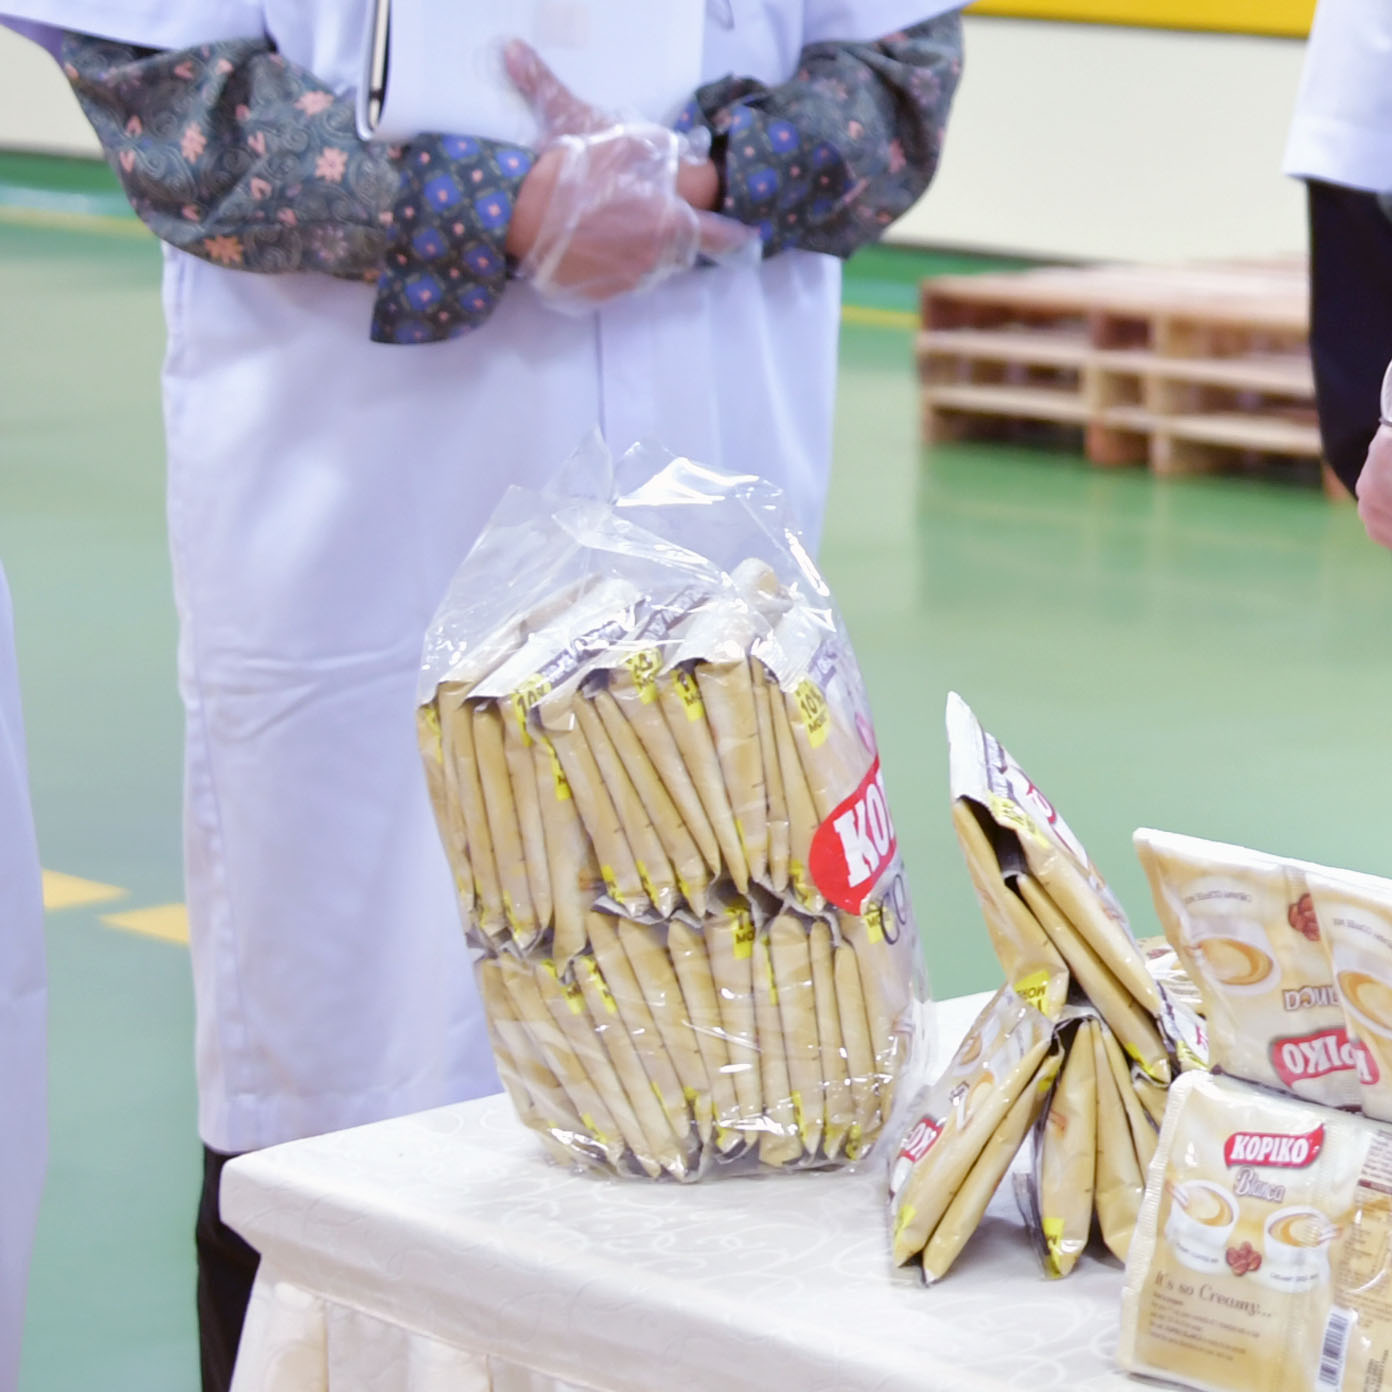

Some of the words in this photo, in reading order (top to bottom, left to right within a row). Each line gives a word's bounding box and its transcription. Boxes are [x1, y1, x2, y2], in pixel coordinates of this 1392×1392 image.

[833, 773, 894, 888] KO
[1282, 984, 1343, 1012] anca
[1230, 1134, 1310, 1163] KOPIKO
